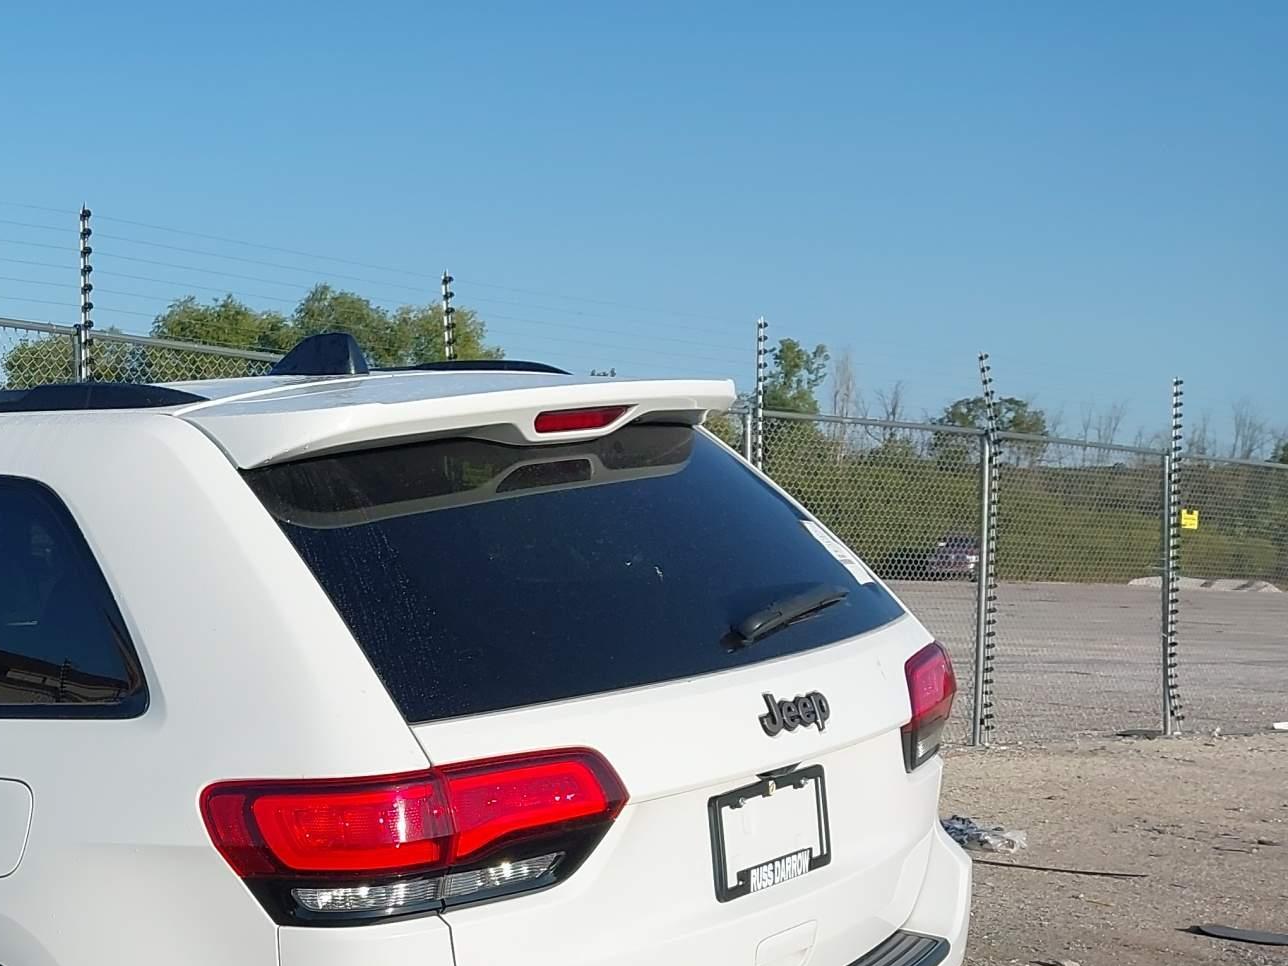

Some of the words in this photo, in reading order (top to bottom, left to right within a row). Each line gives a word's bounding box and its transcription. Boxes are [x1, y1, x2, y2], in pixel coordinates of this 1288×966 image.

[758, 691, 830, 737] Jeep
[750, 863, 774, 893] RUSS
[774, 849, 811, 884] DARROW
